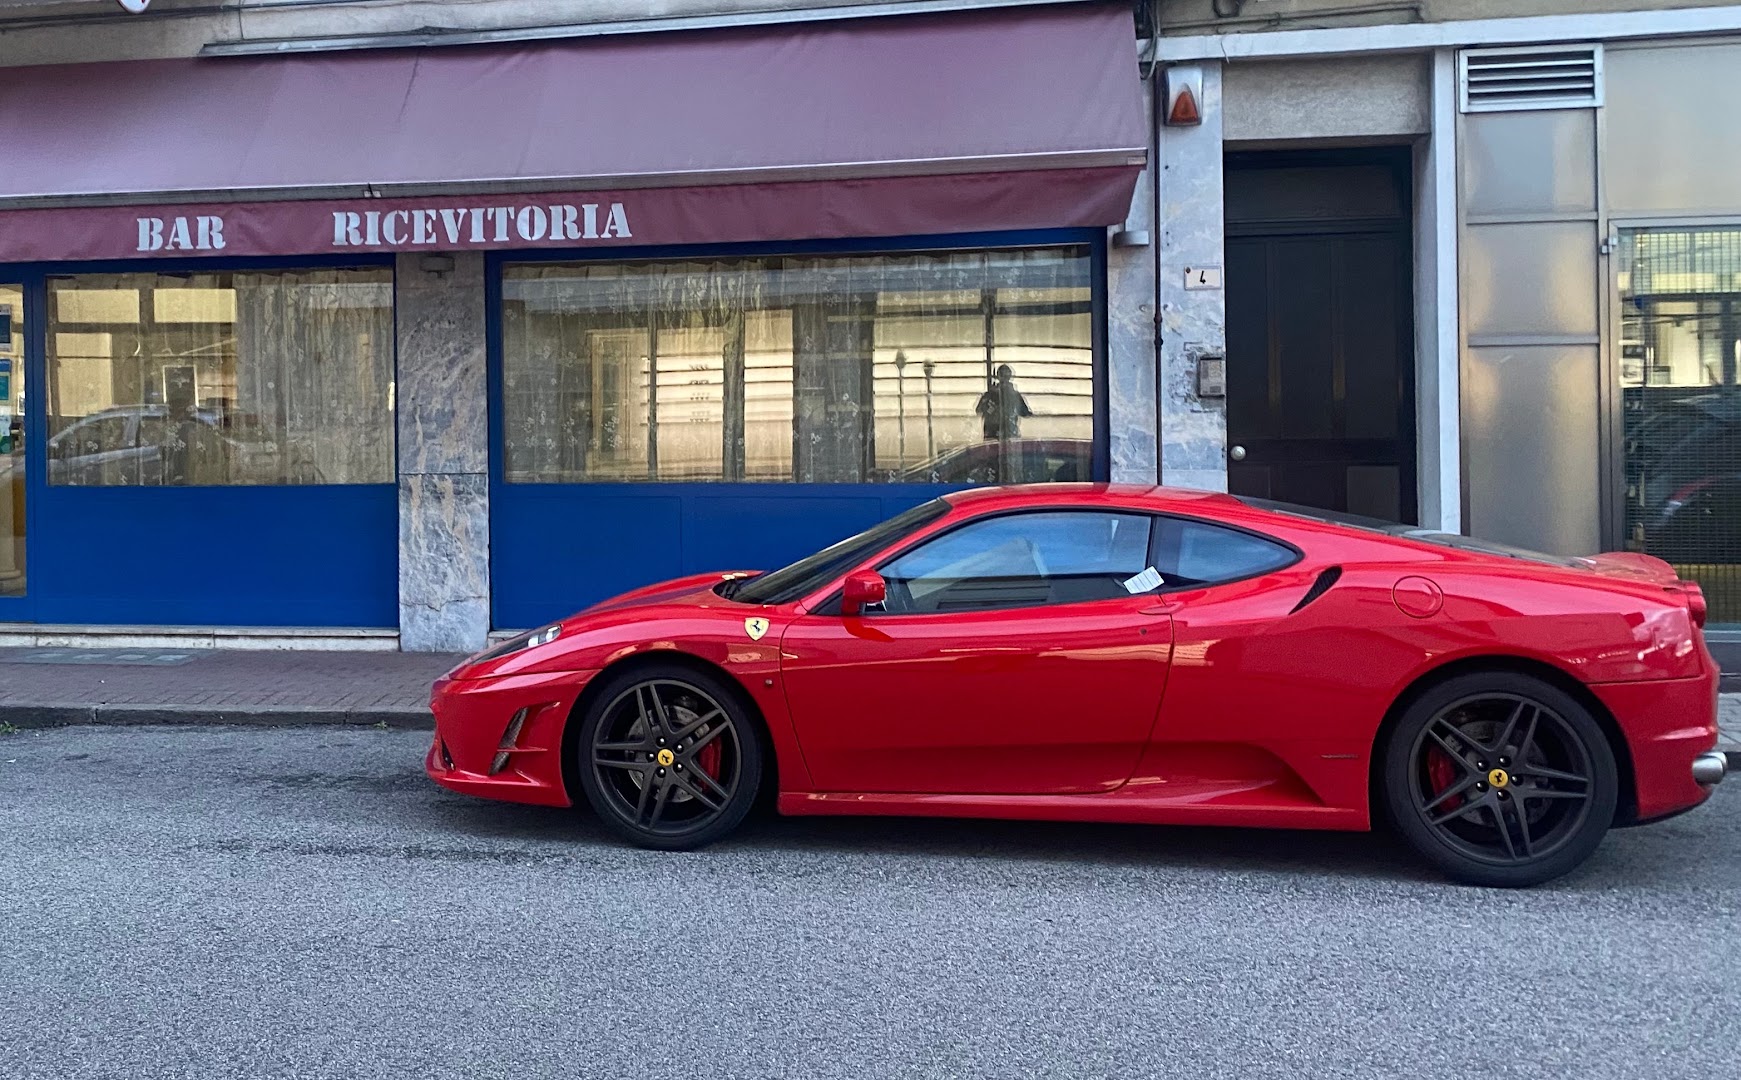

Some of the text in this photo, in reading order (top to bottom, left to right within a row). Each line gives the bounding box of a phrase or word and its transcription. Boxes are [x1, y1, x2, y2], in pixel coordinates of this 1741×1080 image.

[136, 202, 633, 251] BAR RICEVITORIA
[1199, 270, 1207, 284] 4
